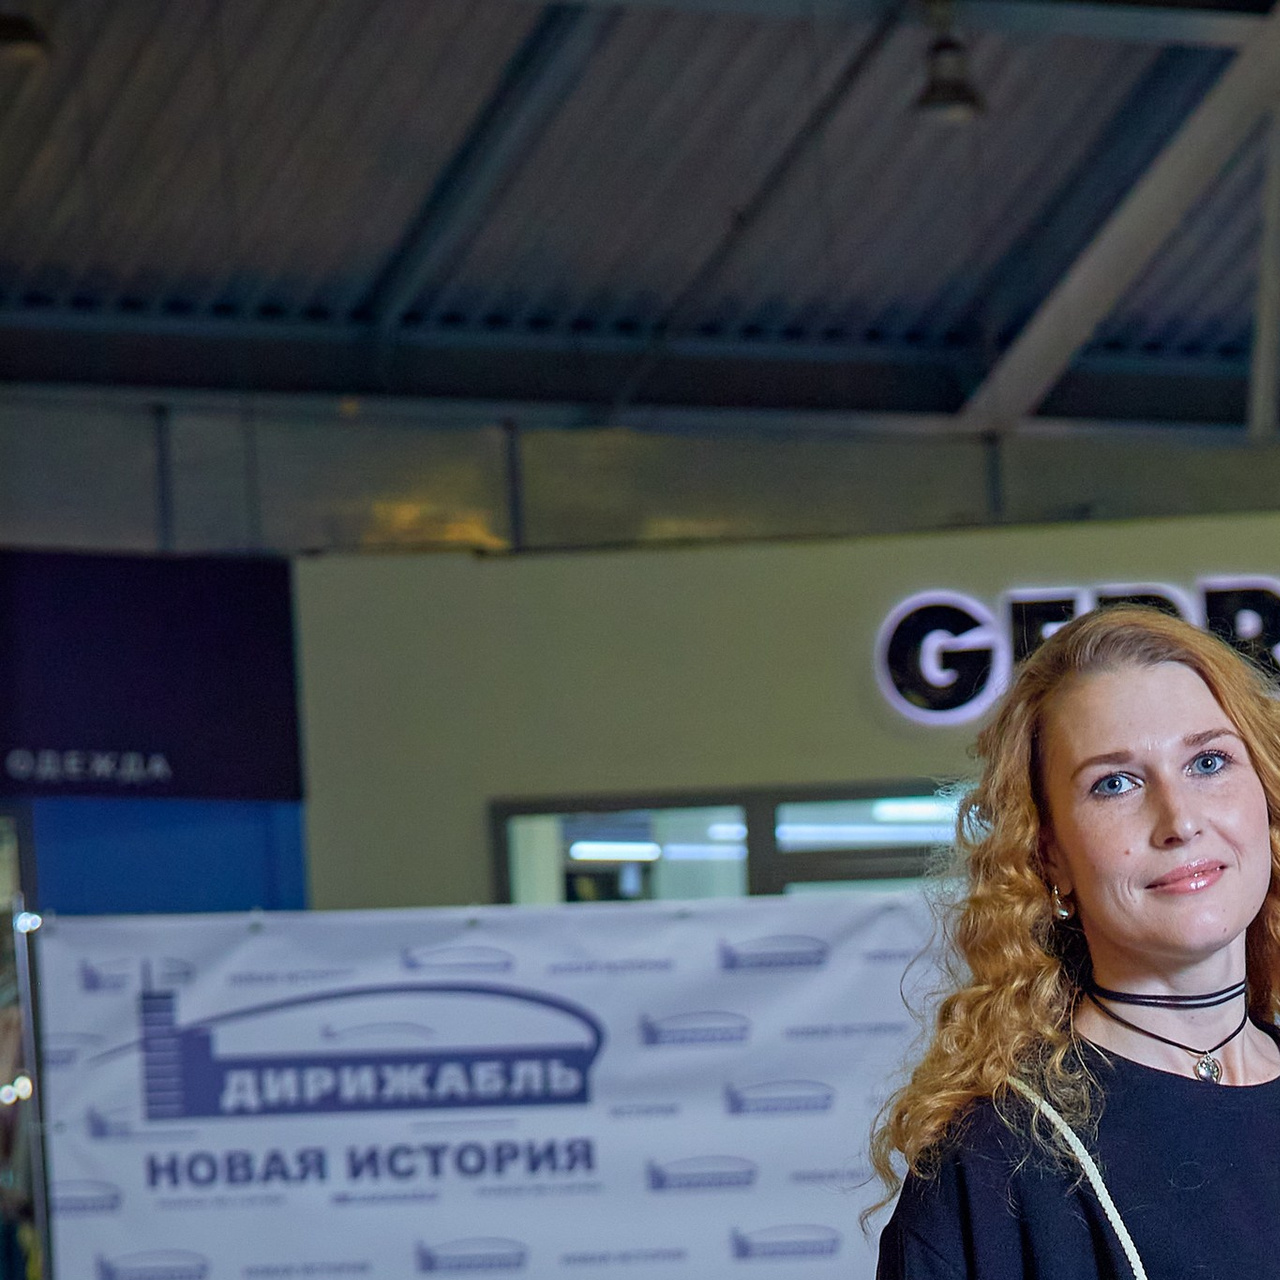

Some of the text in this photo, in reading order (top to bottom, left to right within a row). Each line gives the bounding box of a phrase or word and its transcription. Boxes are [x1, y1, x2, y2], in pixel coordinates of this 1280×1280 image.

[5, 748, 173, 784] ОДЕЖДА
[218, 1058, 583, 1114] ДИРИЖАБЛЬ
[143, 1135, 598, 1191] НОВАЯ ИСТОРИЯ
